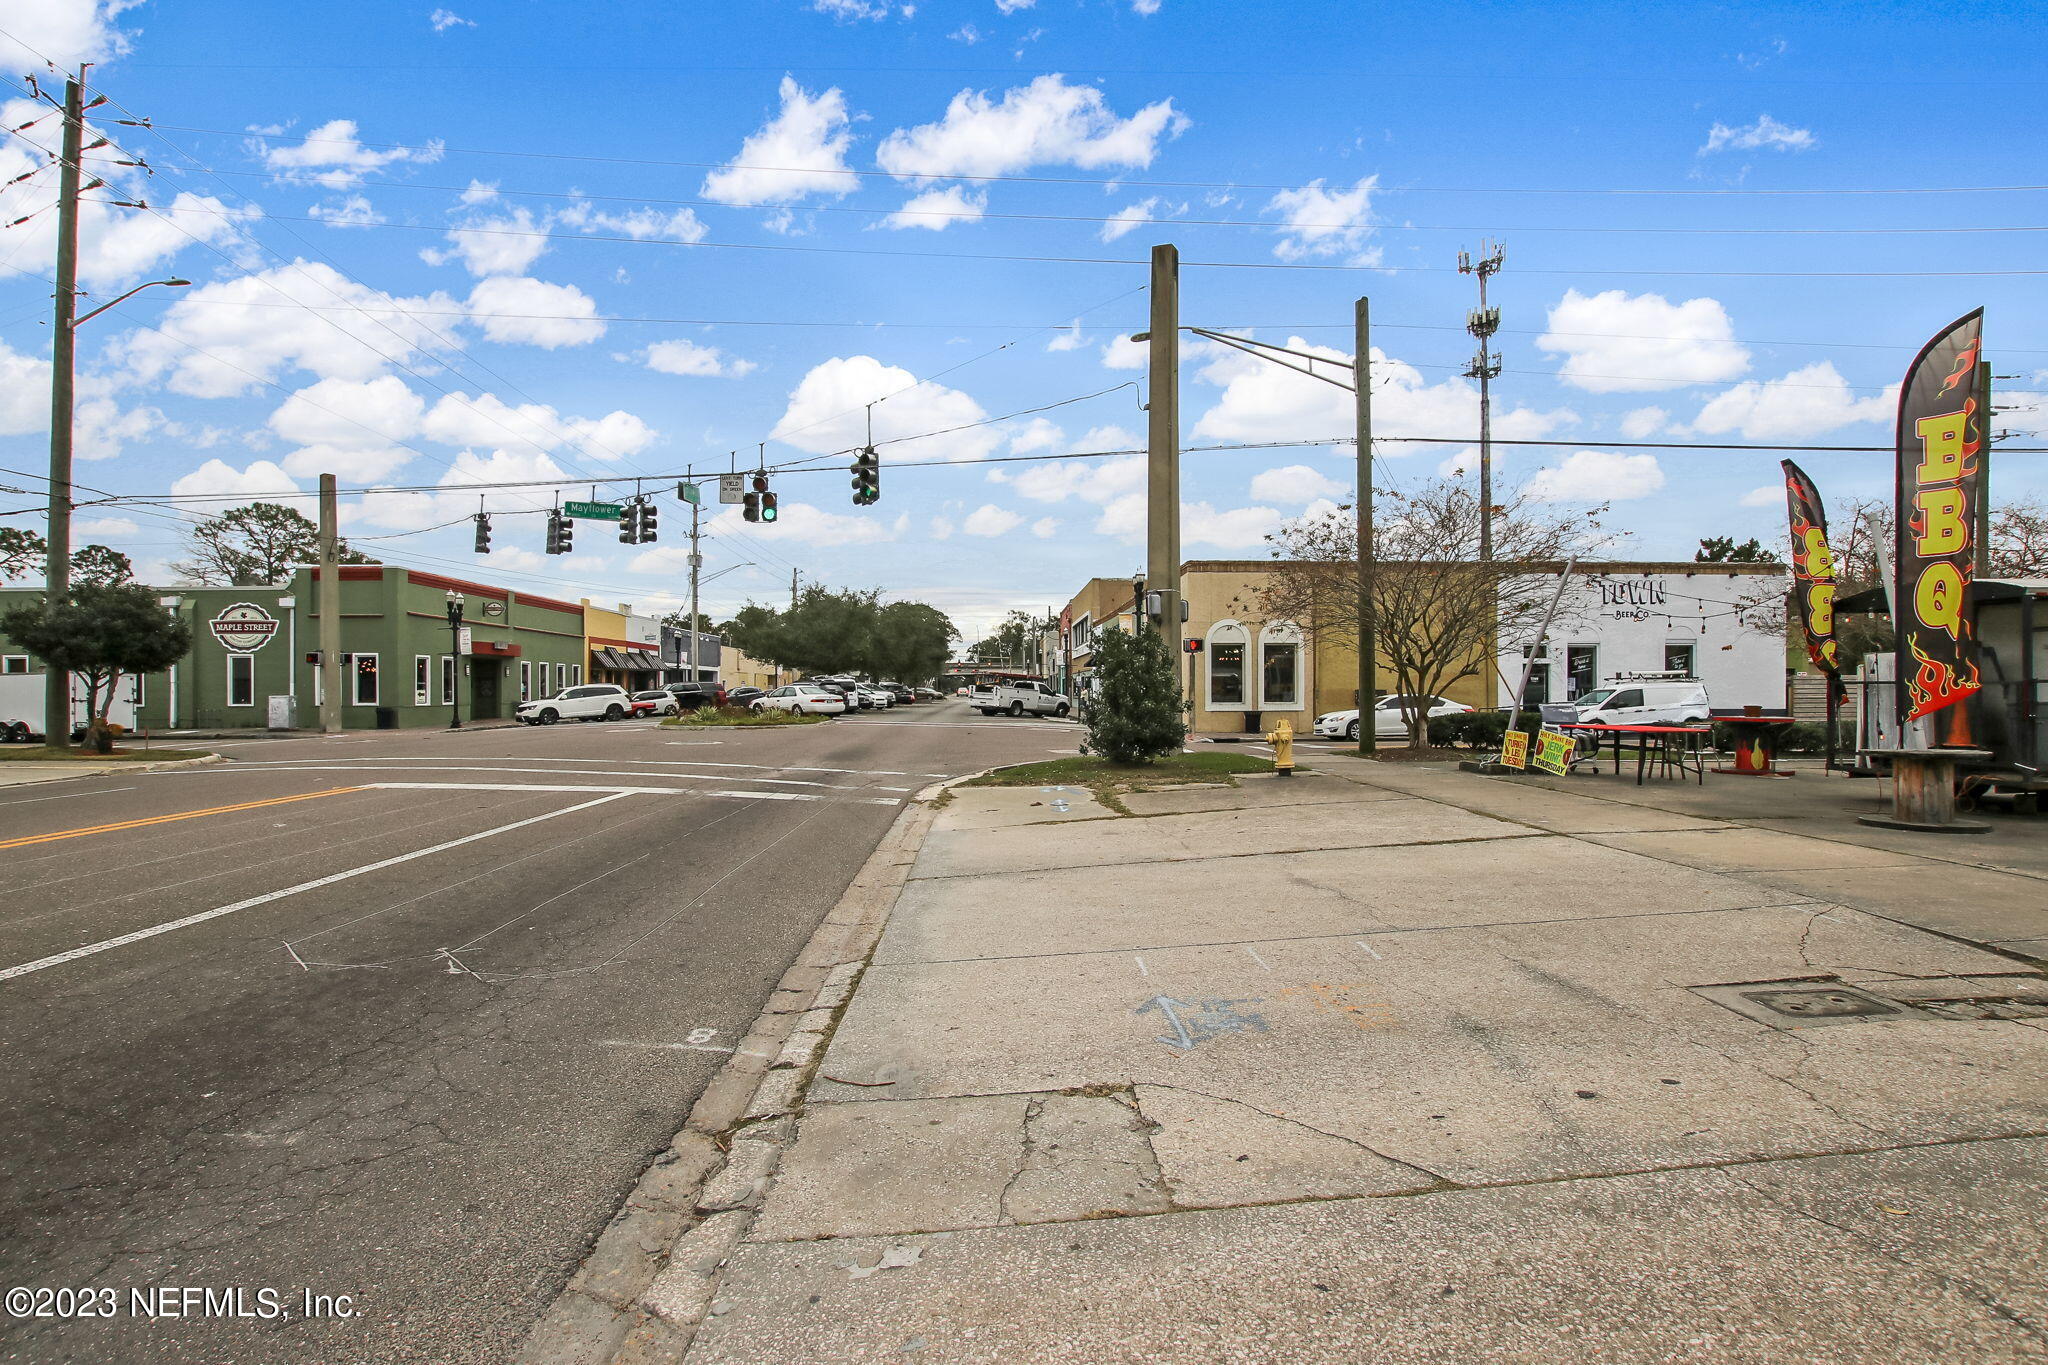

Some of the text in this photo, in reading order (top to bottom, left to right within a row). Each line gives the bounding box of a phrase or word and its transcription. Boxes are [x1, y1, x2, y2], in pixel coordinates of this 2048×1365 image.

[570, 503, 617, 514] Mayflower
[1914, 409, 1968, 641] BBQ
[1600, 579, 1667, 604] TOWN
[1614, 609, 1633, 621] BEER
[216, 623, 273, 631] MAPLE STREET
[1546, 741, 1565, 753] JERK
[1535, 757, 1565, 774] THURSDAY
